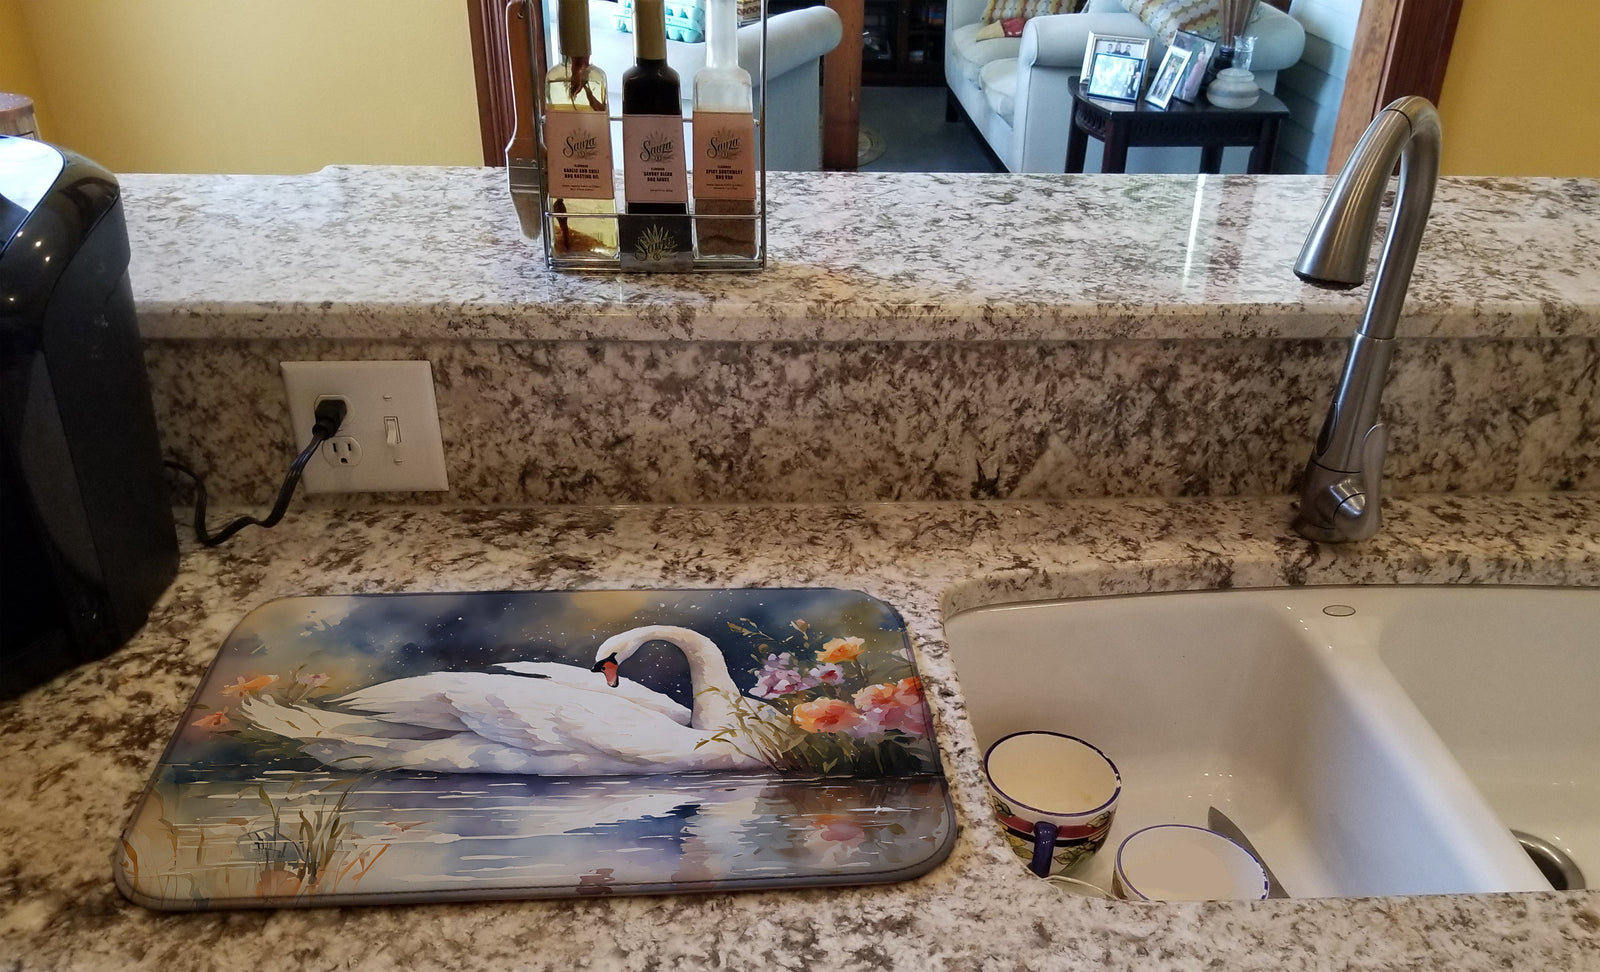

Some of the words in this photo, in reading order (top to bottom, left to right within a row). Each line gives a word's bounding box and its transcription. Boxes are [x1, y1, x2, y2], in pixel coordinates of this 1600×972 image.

[563, 136, 598, 158] Sauza
[640, 140, 674, 161] Sauza
[707, 136, 740, 159] Sauza
